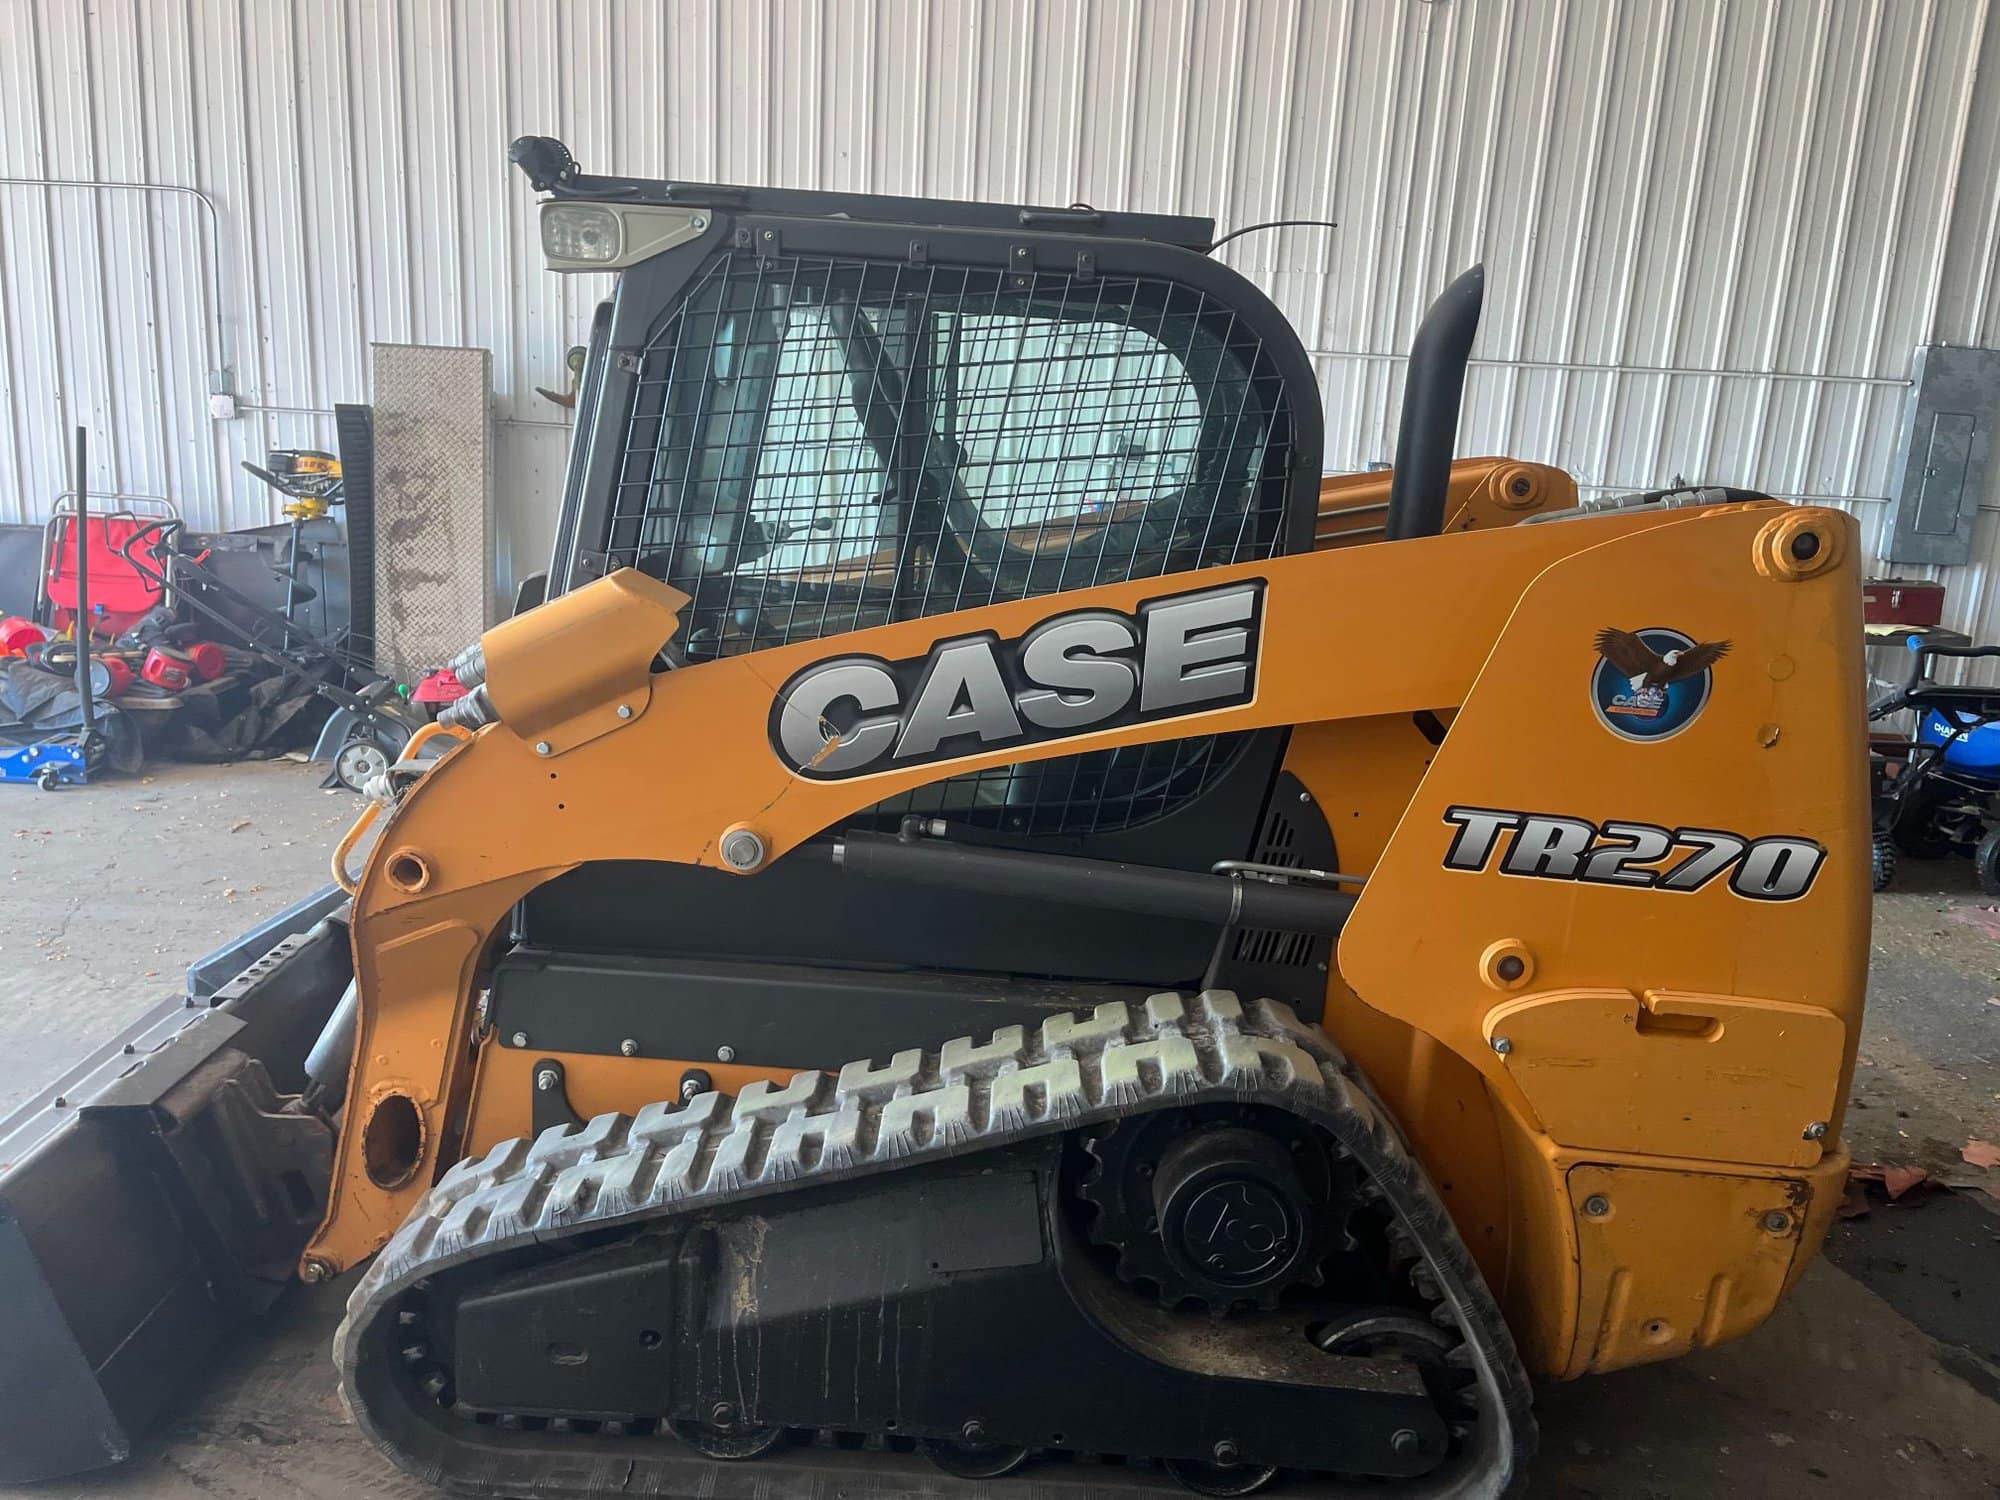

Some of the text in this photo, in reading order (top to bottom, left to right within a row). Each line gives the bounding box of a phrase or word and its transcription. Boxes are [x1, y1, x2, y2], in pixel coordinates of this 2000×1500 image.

[774, 585, 1259, 774] CASE
[1611, 694, 1664, 709] CASE
[1934, 722, 1969, 740] CHAPN
[1446, 807, 1823, 897] TR270
